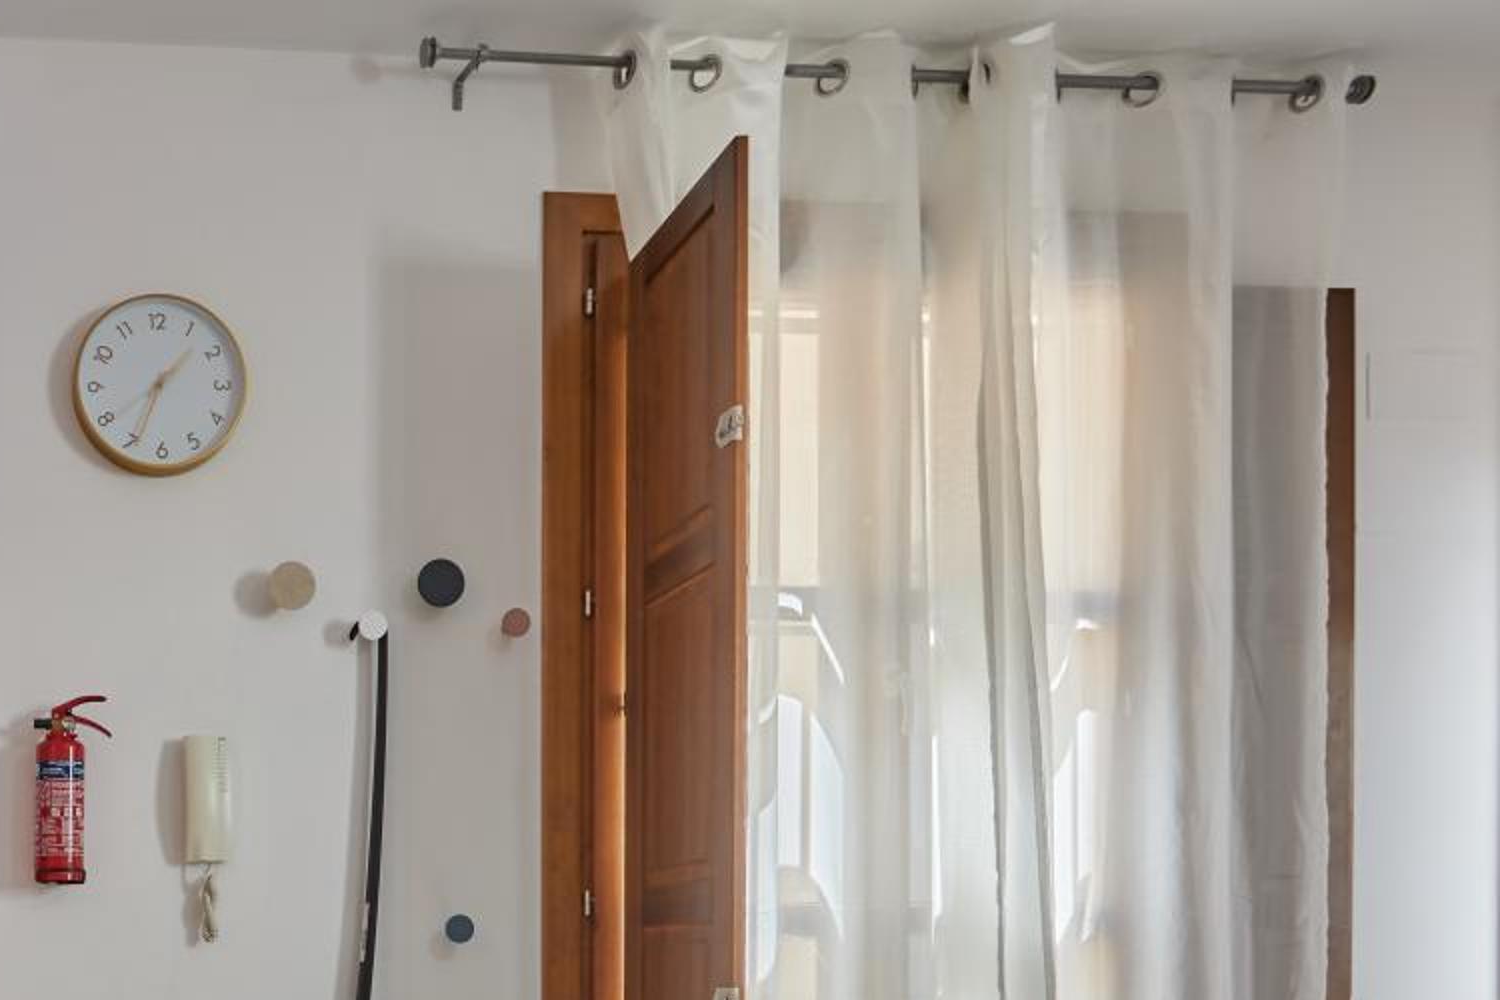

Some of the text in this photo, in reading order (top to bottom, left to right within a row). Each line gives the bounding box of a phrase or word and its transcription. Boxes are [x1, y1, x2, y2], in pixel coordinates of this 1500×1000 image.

[148, 312, 166, 331] 12
[185, 321, 195, 337] 1
[116, 321, 133, 340] 11
[93, 345, 113, 364] 10
[204, 345, 221, 361] 2
[87, 381, 105, 393] 9
[213, 379, 231, 392] 3
[97, 411, 115, 427] 8
[209, 409, 225, 426] 4
[122, 432, 140, 449] 7
[187, 432, 200, 451] 5
[156, 441, 169, 460] 6
